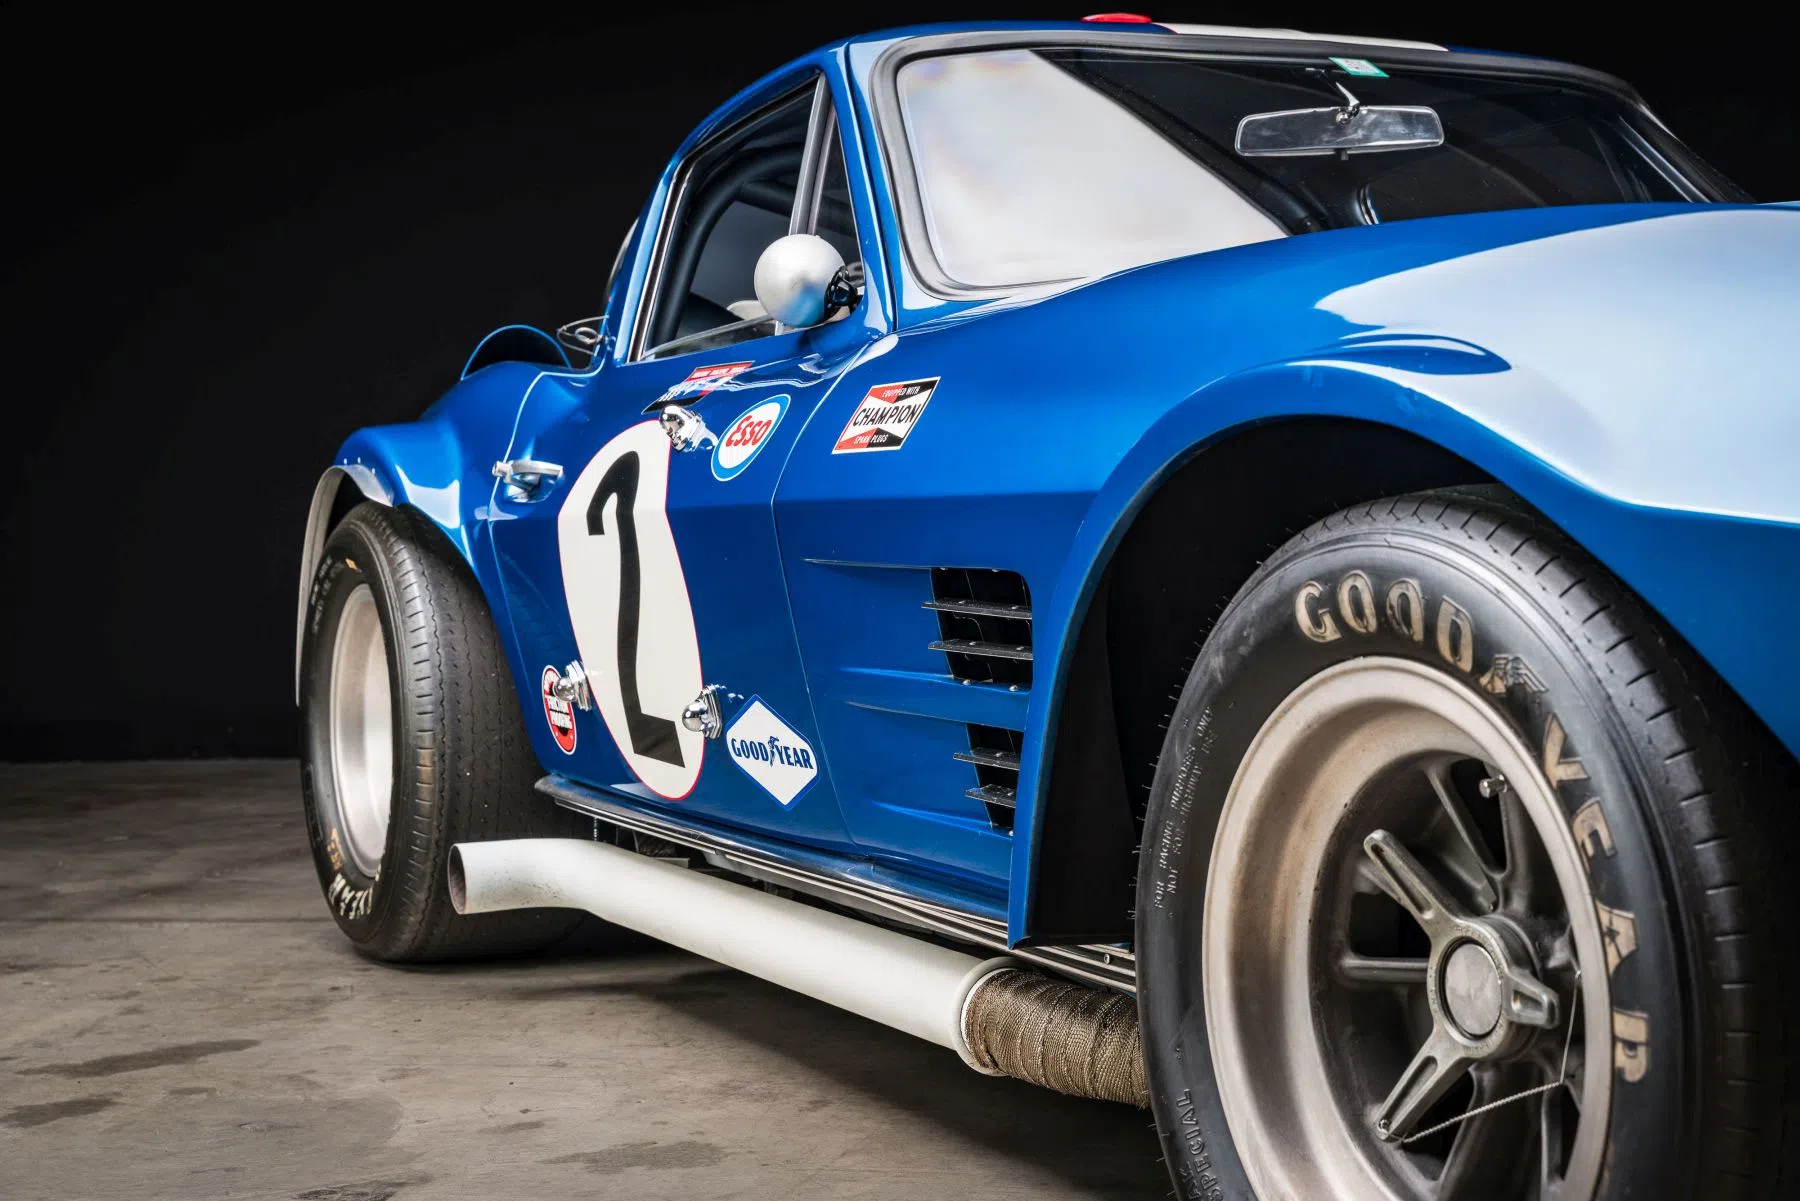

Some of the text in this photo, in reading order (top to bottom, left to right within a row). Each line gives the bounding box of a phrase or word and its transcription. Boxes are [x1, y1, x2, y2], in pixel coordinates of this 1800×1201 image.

[881, 385, 921, 398] EQUIPPED WITH
[852, 403, 922, 427] CHAMPION
[586, 450, 686, 768] 2
[1166, 866, 1179, 894] NOT
[1176, 1088, 1223, 1201] SPECIAL
